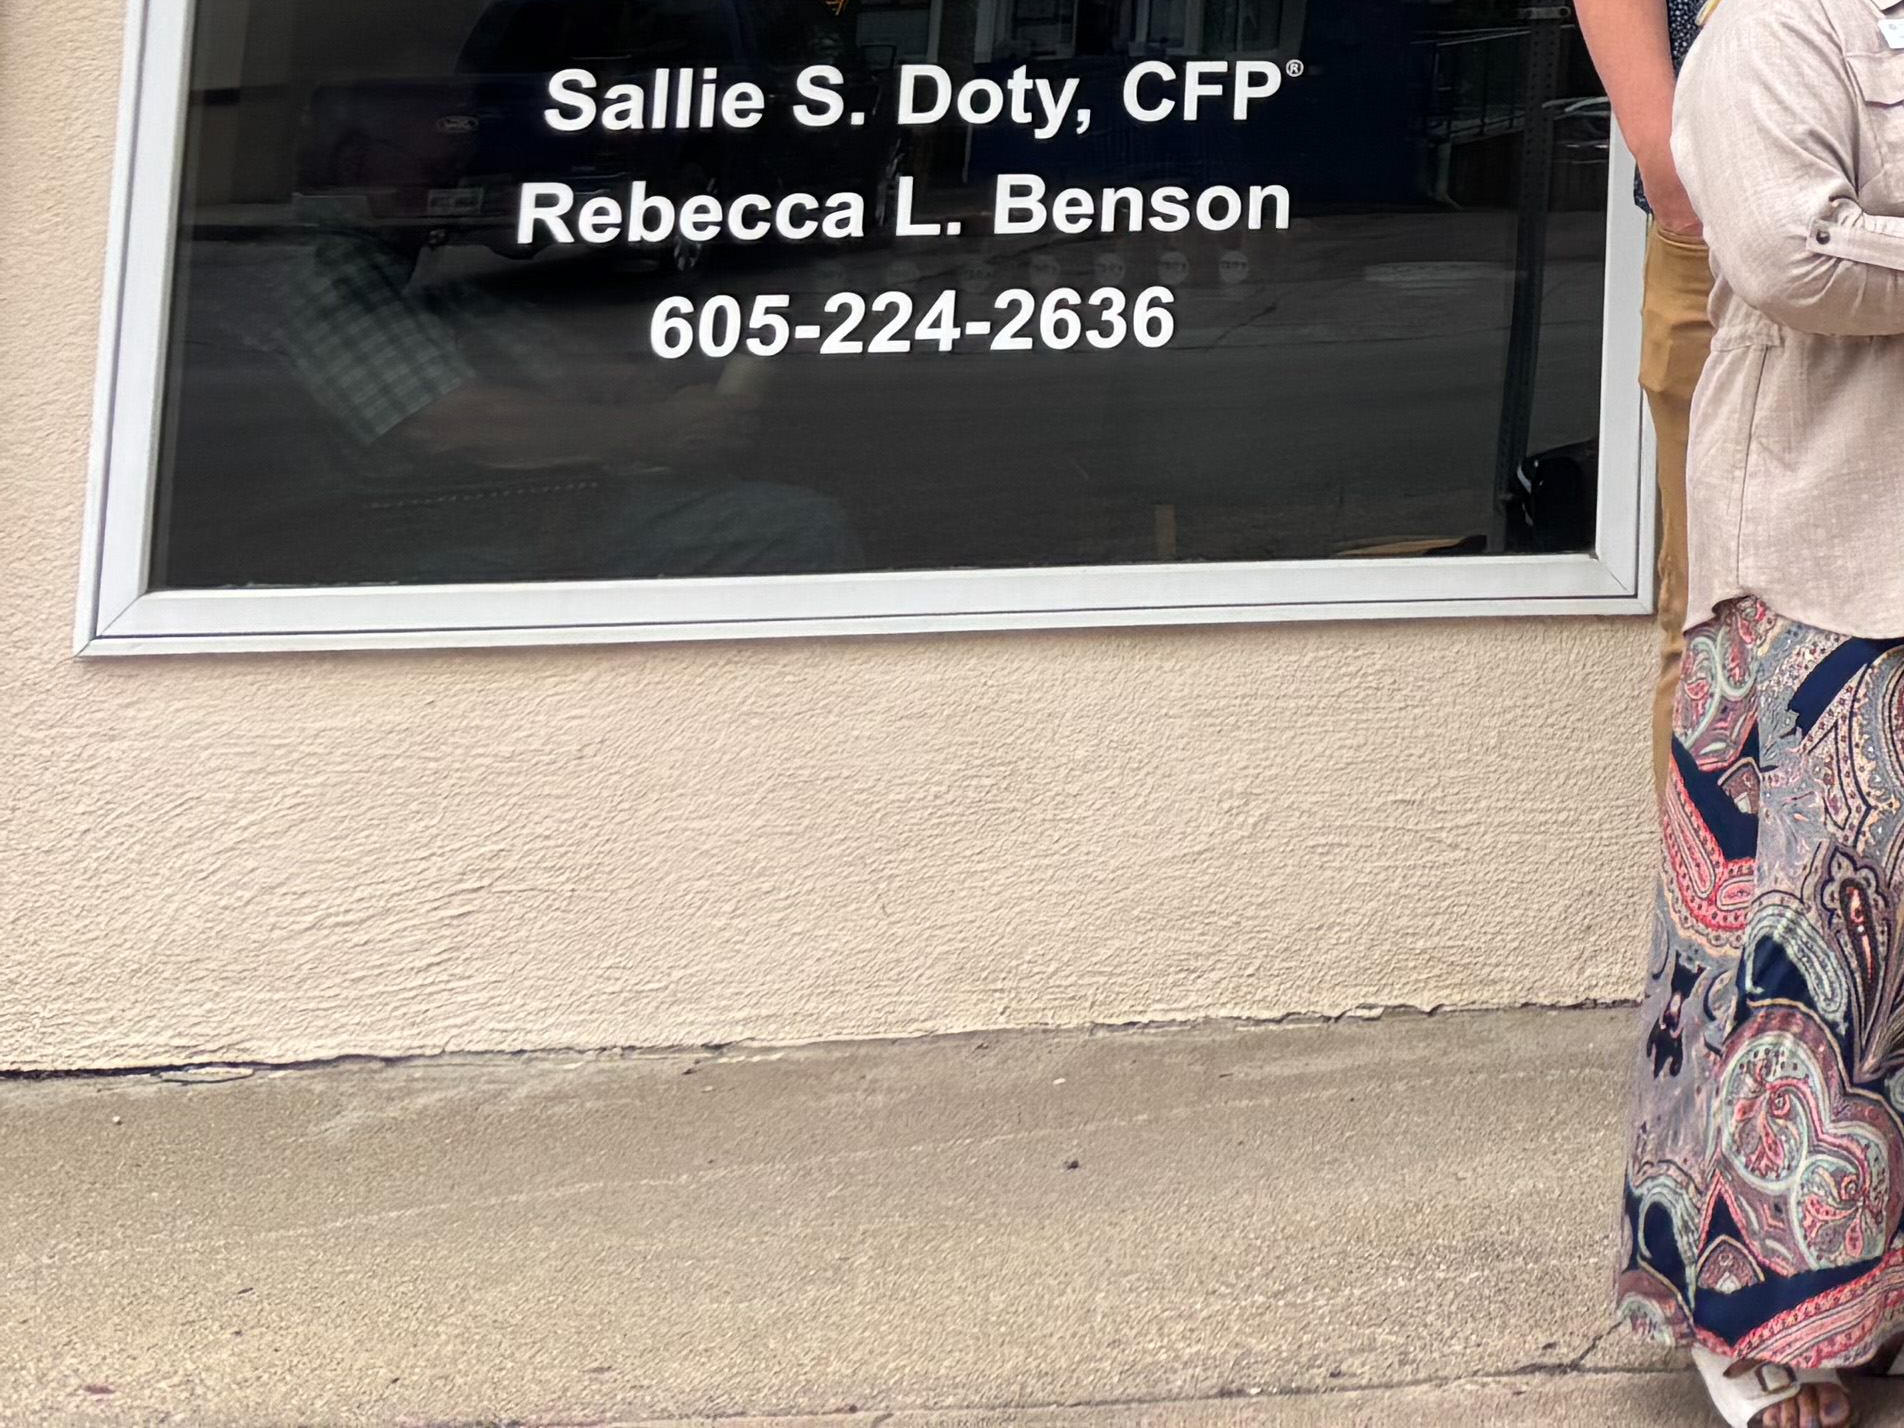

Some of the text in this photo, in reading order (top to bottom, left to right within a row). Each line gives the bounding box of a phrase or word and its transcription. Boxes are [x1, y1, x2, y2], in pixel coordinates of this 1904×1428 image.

[544, 66, 765, 132] Sallie
[792, 63, 866, 127] S.
[897, 63, 1092, 141] Doty,
[516, 172, 1291, 245] Rebecca L. Benson
[649, 284, 1176, 360] 605-224-2636
